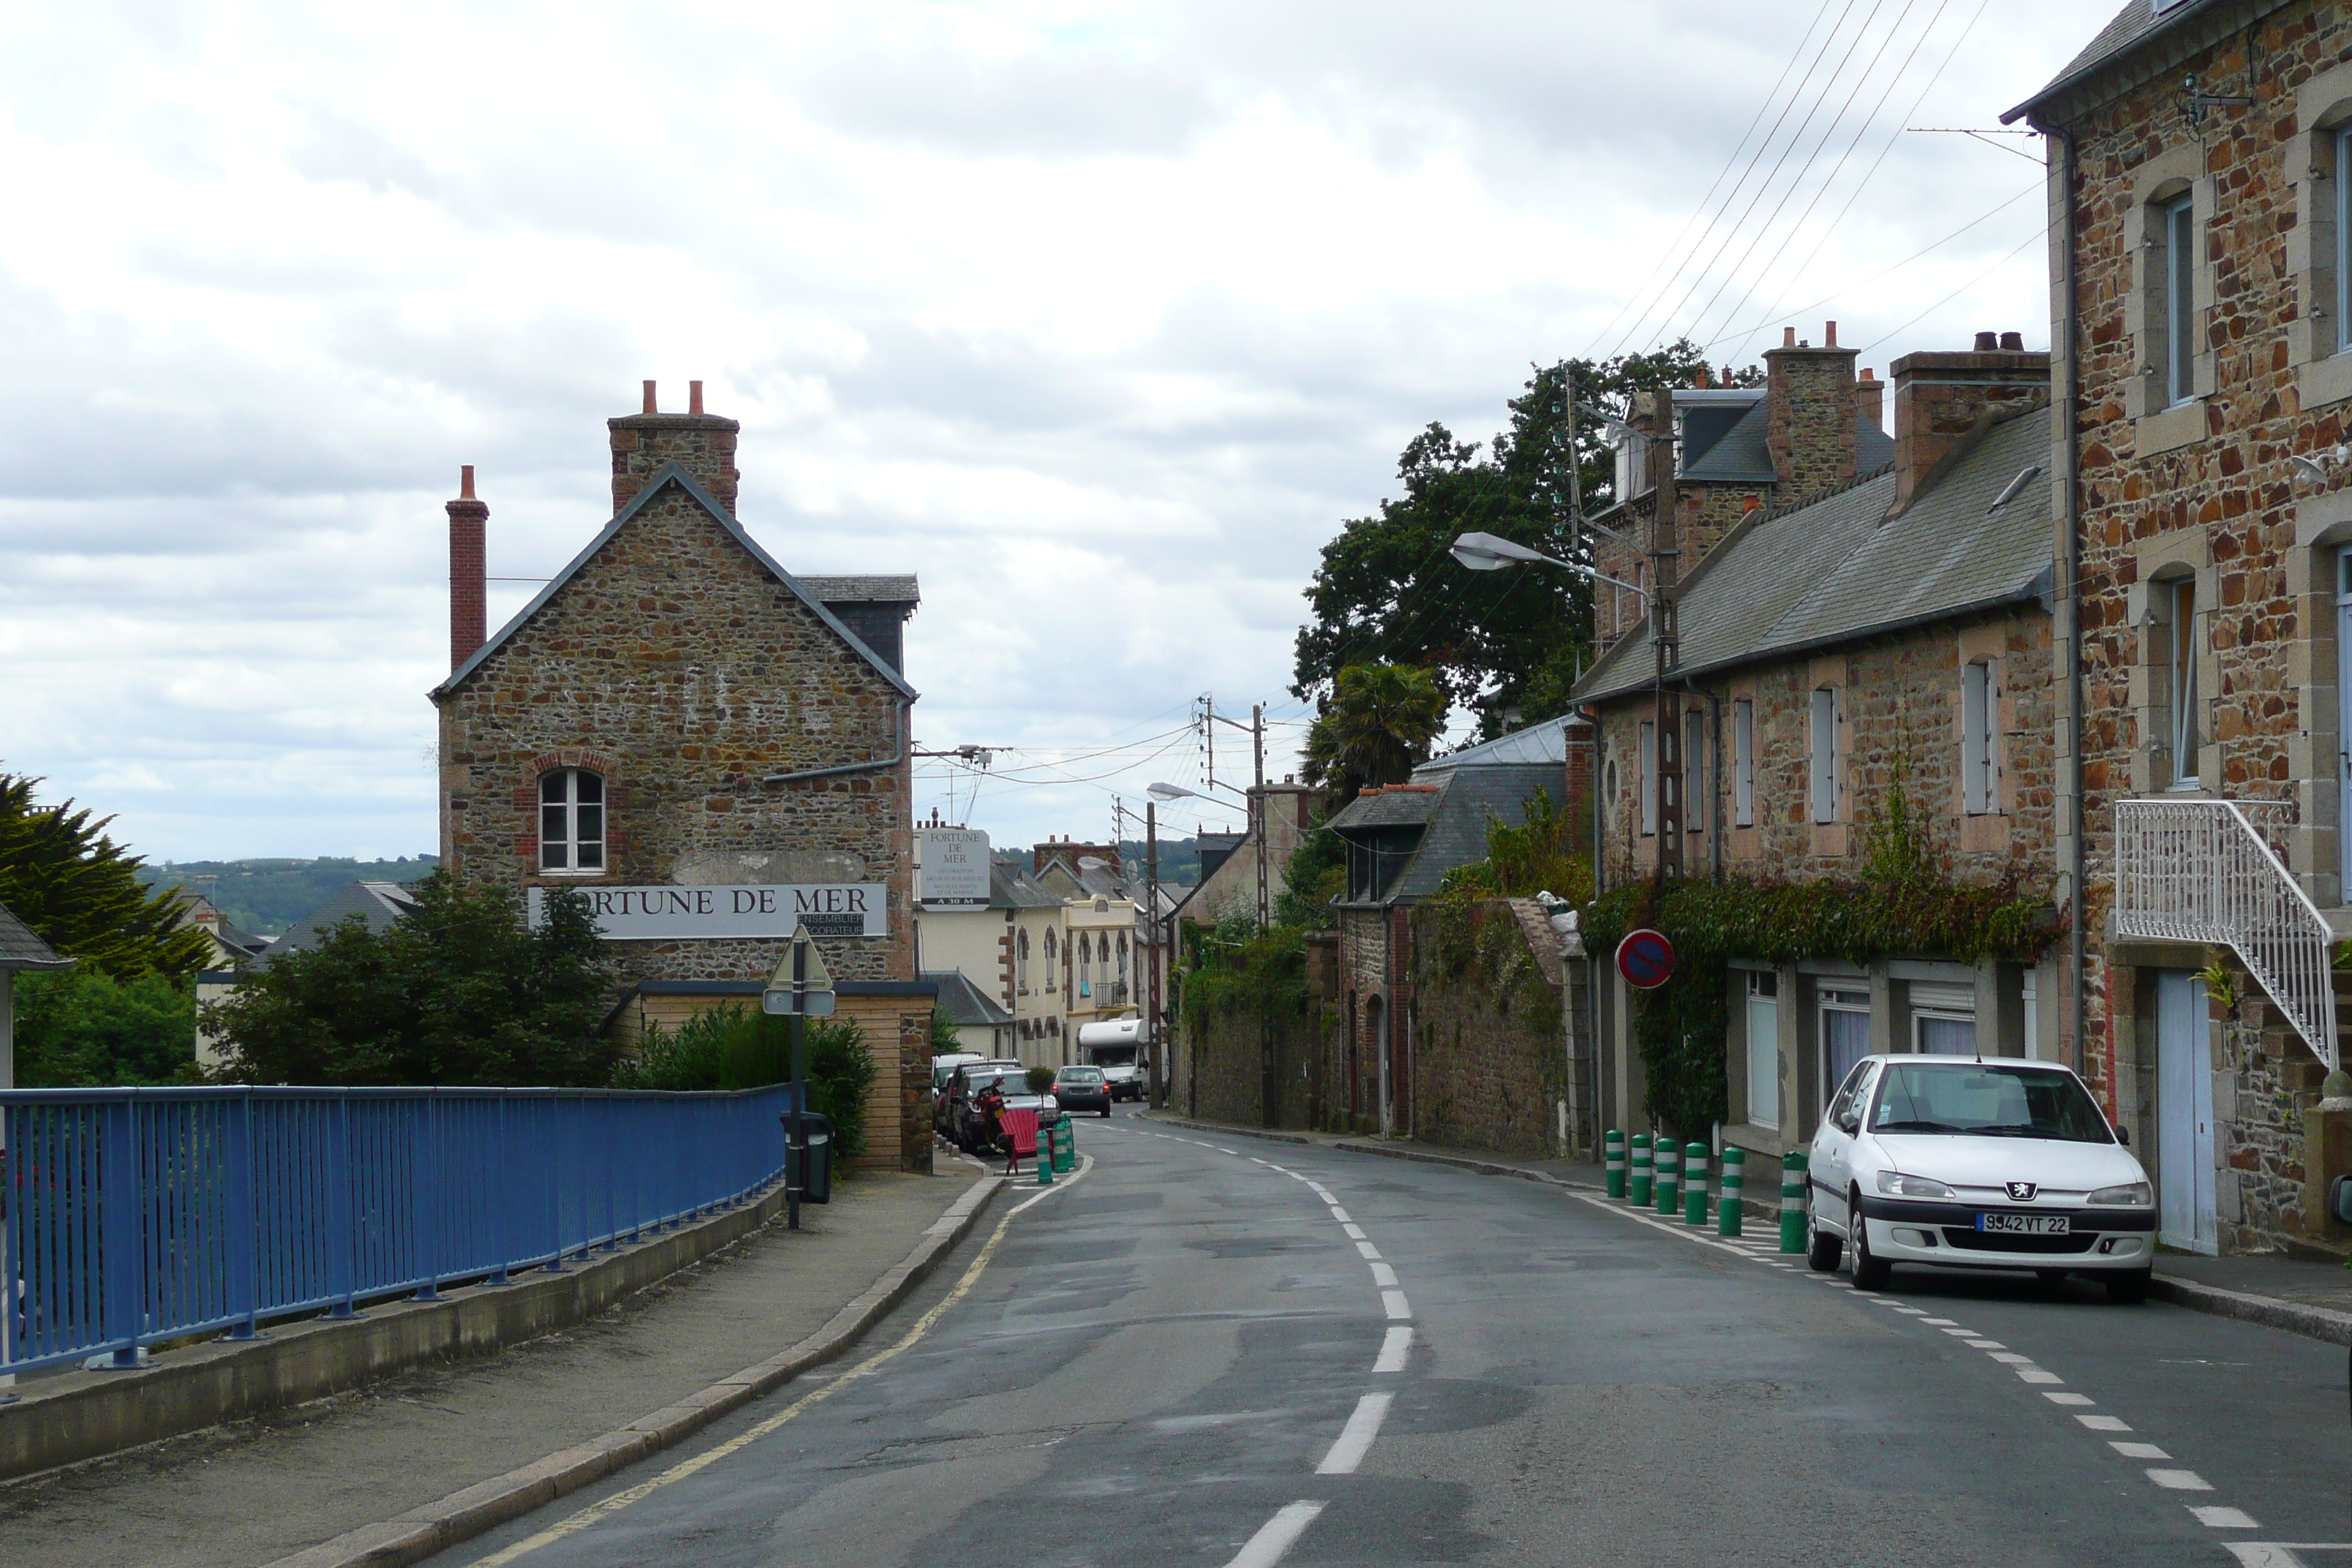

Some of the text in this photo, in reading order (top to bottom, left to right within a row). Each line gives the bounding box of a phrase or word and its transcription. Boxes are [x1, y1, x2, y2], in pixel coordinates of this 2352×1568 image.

[931, 833, 980, 843] FORTUNE
[949, 843, 962, 853] DE
[944, 854, 967, 863] MER
[574, 889, 869, 915] ORTUNE DE MER
[798, 914, 864, 923] ENSEMBLIER
[806, 926, 864, 935] ECORATEUR
[1986, 1215, 2066, 1233] 9942 VT 22
